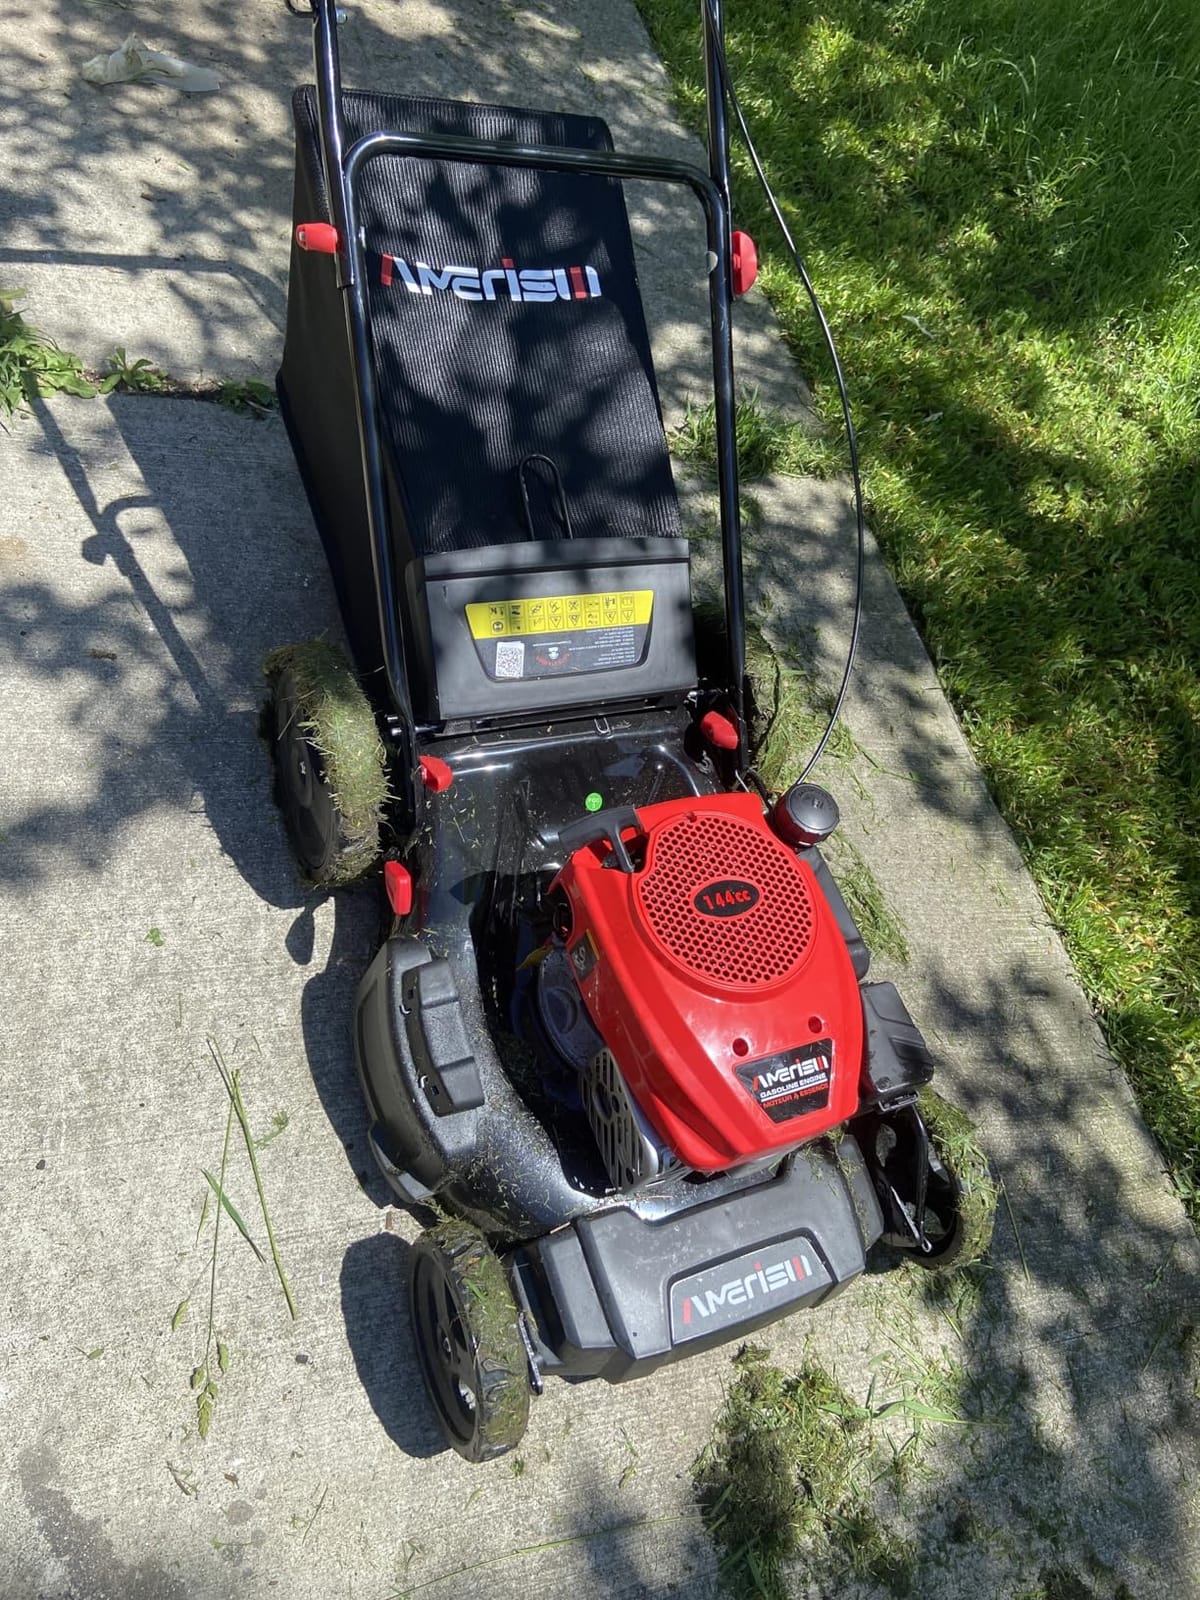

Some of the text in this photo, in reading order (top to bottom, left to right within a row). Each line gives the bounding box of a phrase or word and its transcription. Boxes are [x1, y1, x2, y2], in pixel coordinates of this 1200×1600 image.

[703, 890, 751, 910] 144cc
[760, 1072, 826, 1099] GASOLINE ENGINE
[763, 1094, 792, 1108] MOTEUR
